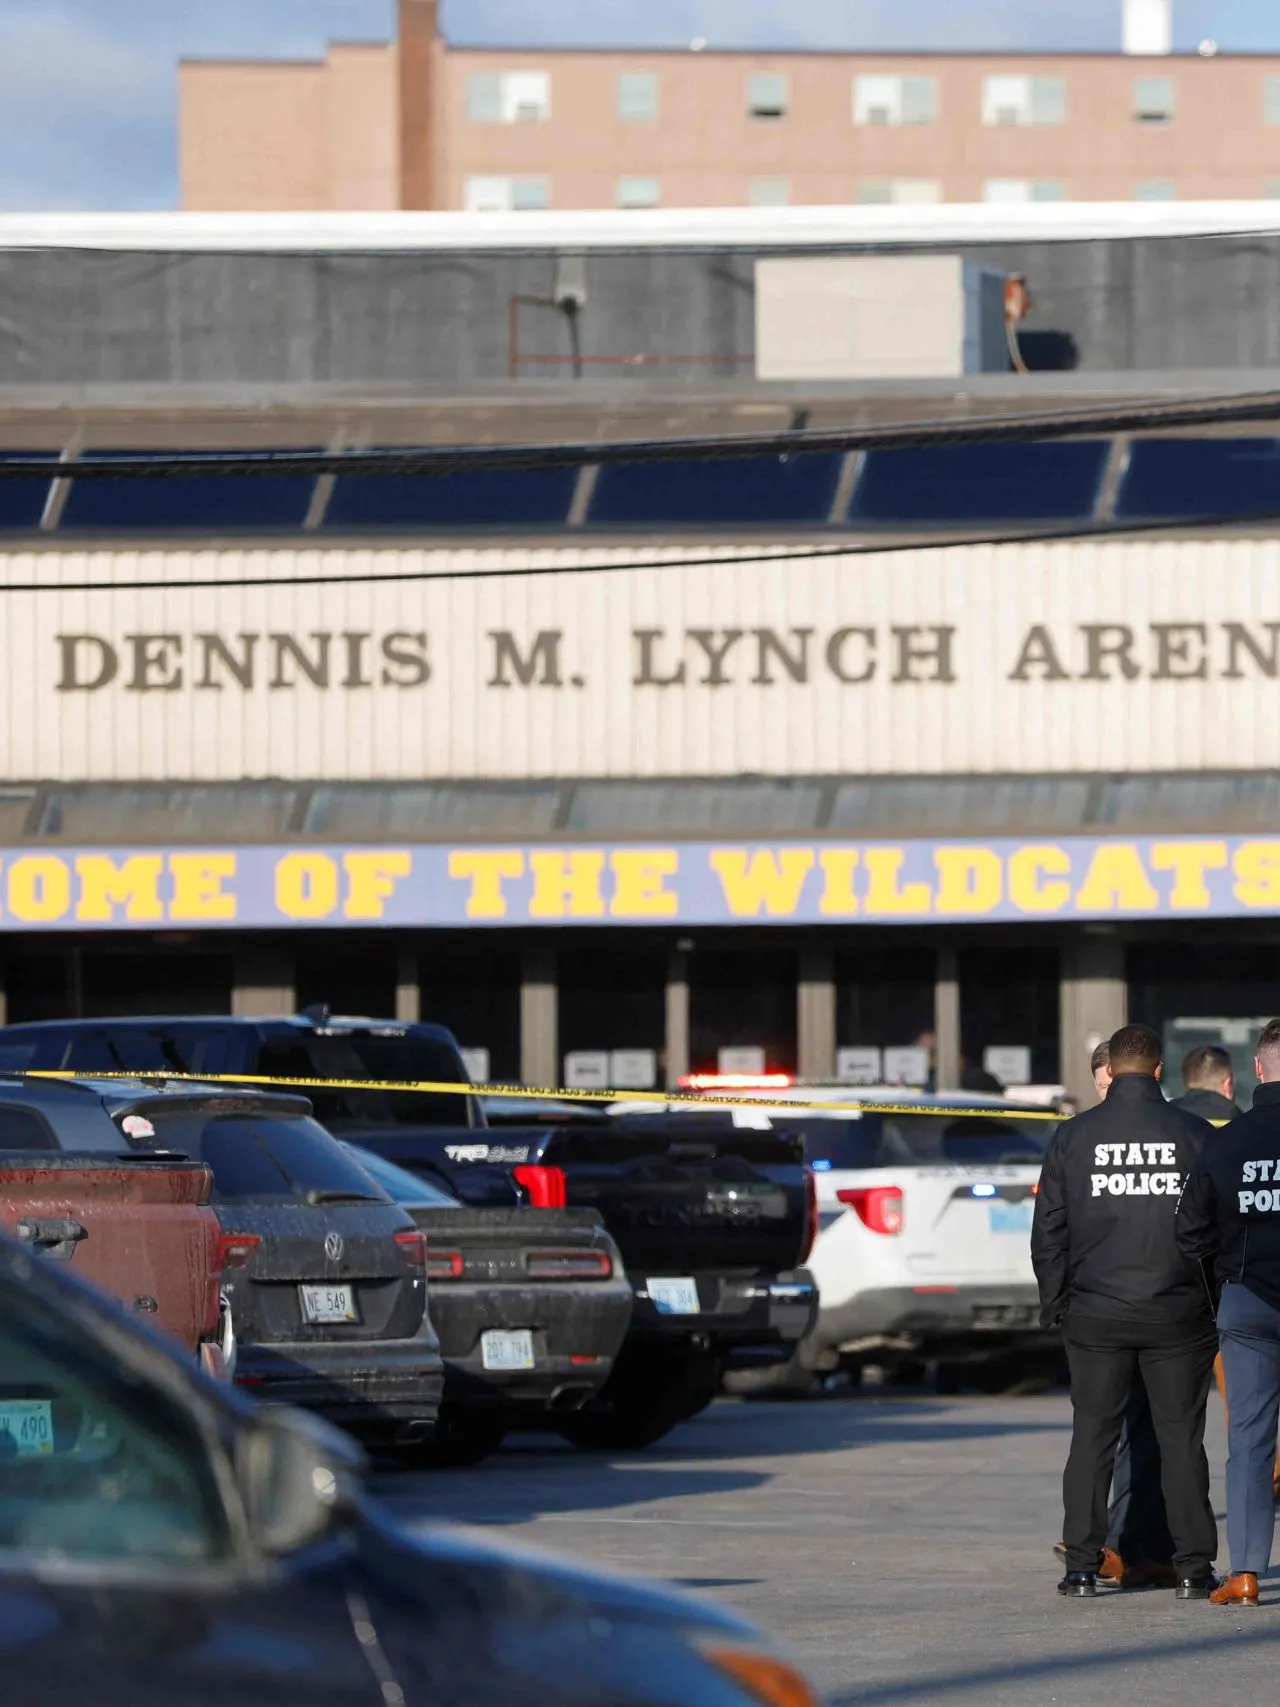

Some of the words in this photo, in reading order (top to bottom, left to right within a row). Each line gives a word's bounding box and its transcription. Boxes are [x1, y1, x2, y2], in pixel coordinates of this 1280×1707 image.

[55, 627, 433, 693] DENNIS
[486, 629, 586, 690] M.
[632, 624, 957, 688] LYNCH
[0, 852, 238, 922] OME
[274, 851, 412, 919] OF
[448, 850, 679, 919] THE
[1094, 1142, 1176, 1166] STATE
[1090, 1172, 1181, 1197] POLICE
